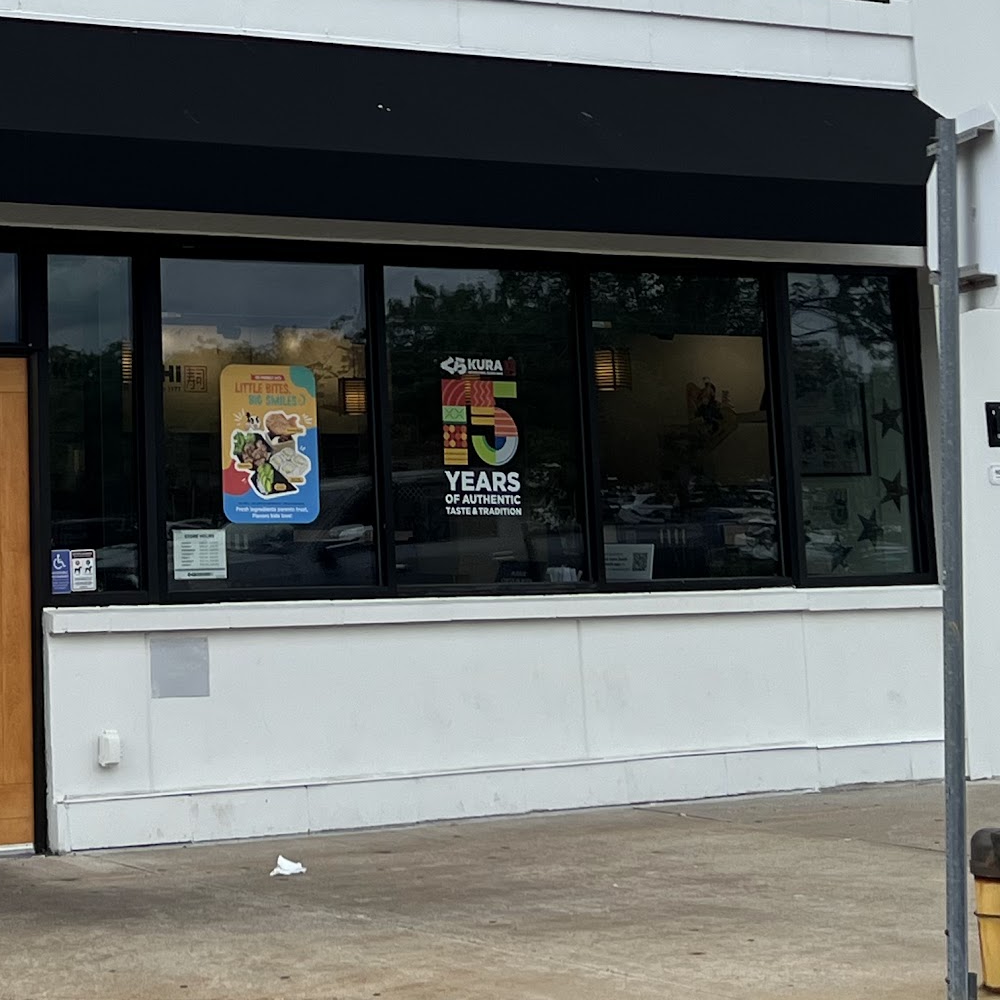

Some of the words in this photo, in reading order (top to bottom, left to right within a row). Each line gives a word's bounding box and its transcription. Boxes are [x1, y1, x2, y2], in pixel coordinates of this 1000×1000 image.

[467, 358, 504, 371] KURA
[235, 382, 262, 393] LITTLE
[444, 470, 521, 492] YEARS
[445, 493, 461, 505] OF
[462, 493, 521, 505] AUTHENTIC
[445, 506, 471, 515] TASTE
[472, 506, 478, 515] &
[478, 506, 522, 516] TRADITION
